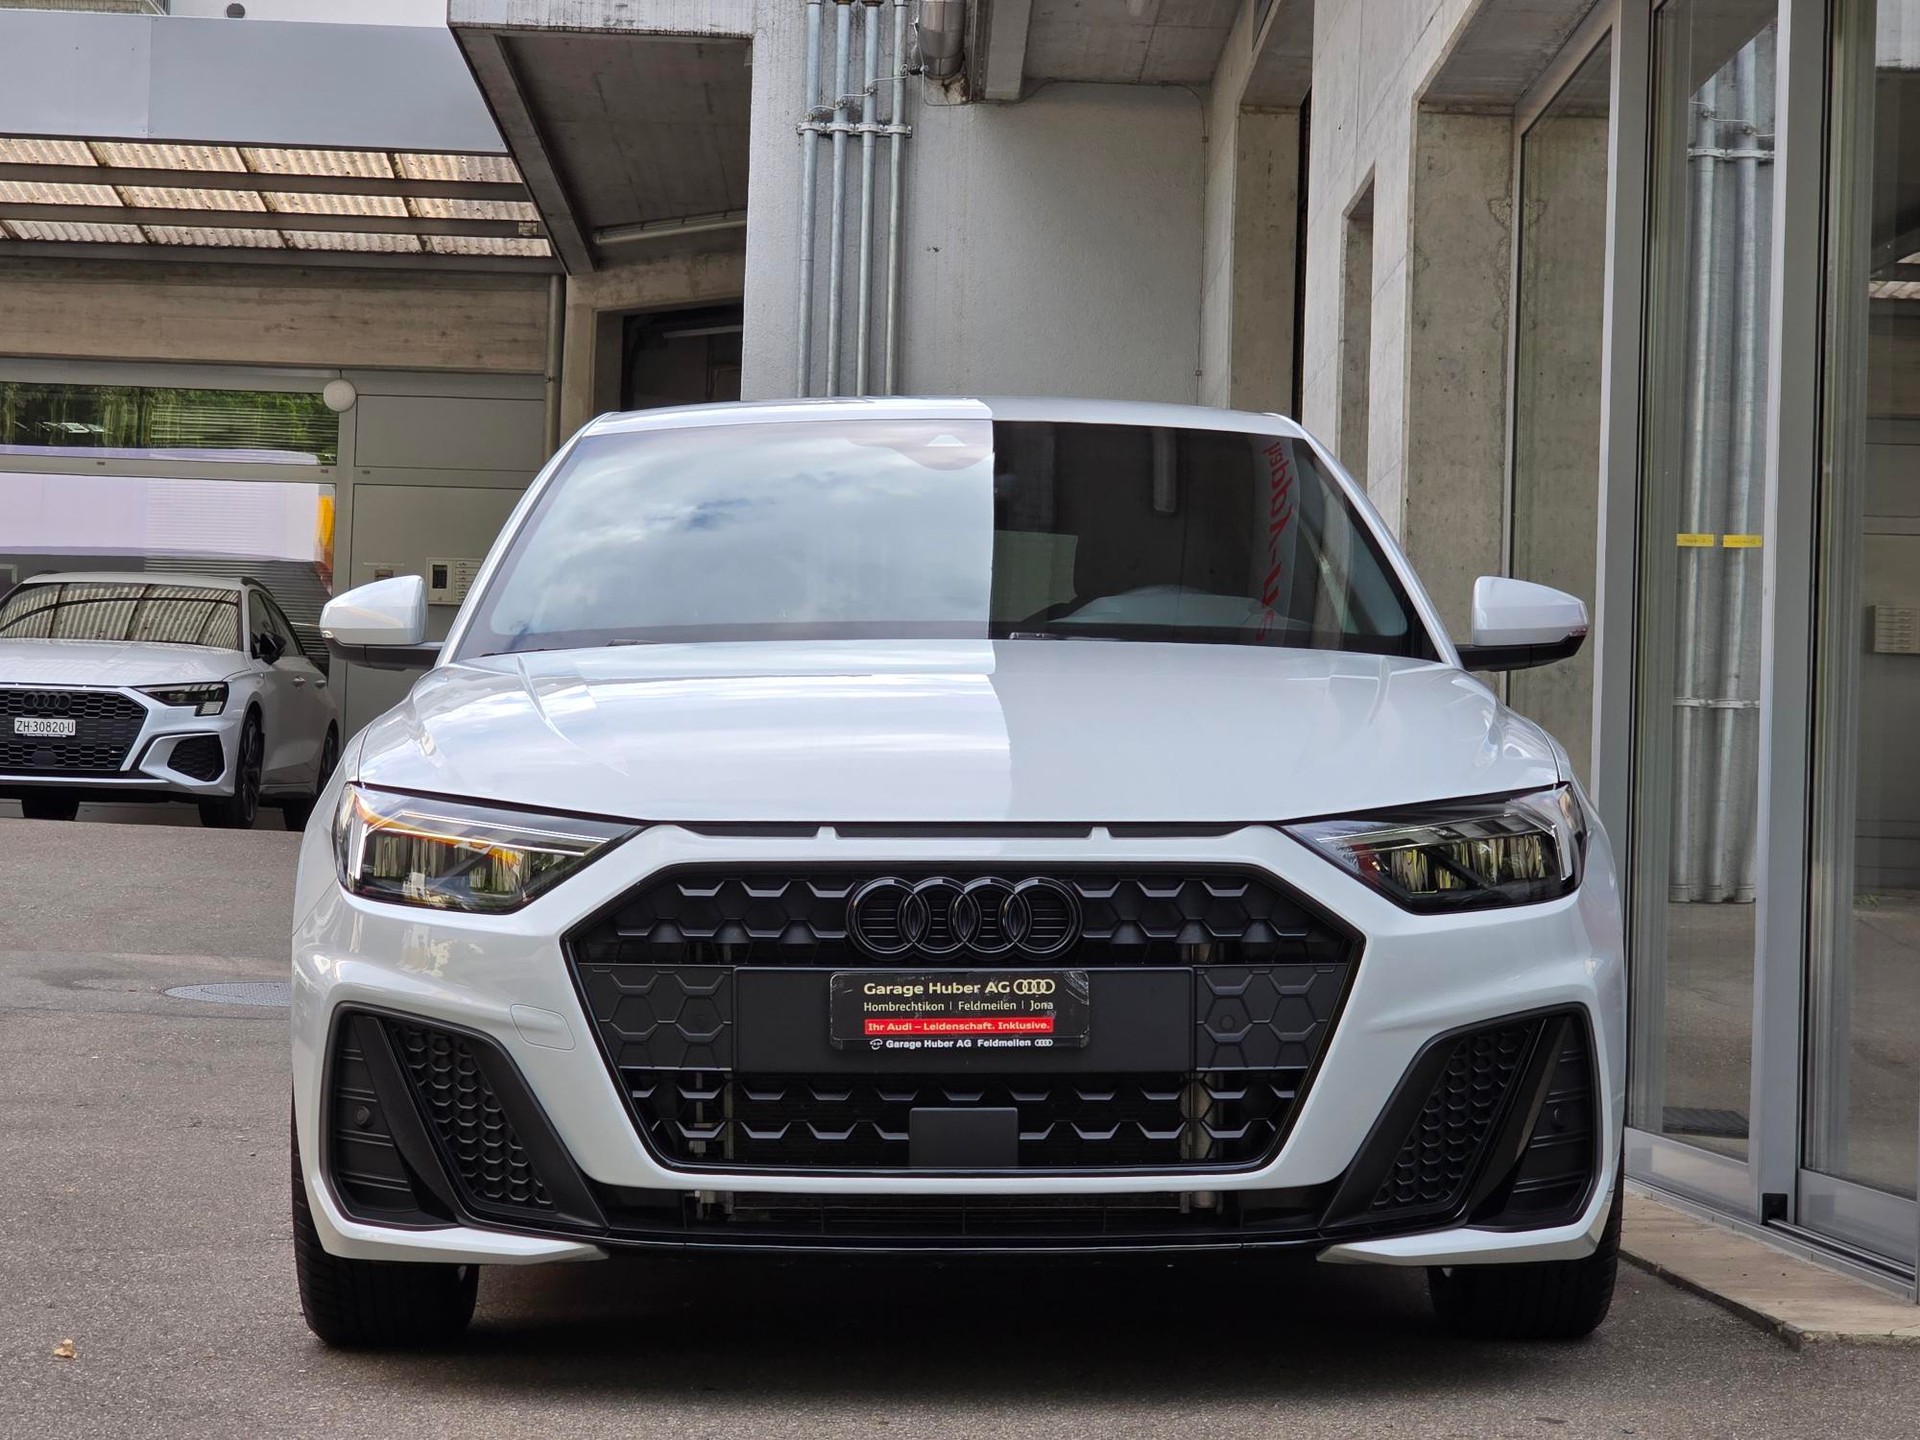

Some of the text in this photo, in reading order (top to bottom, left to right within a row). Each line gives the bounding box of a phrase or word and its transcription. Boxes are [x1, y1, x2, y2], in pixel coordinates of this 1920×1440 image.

[863, 981, 1010, 997] Garage Huber AG
[864, 1000, 1054, 1012] Hombrechtikon Feldmeilen Jona
[868, 1022, 885, 1031] Ihr
[887, 1022, 912, 1031] Audi
[922, 1022, 996, 1031] Leidenschaft.
[998, 1021, 1051, 1030] Inklusive.
[886, 1038, 1031, 1049] Garage Huber AG Feldmeilen
